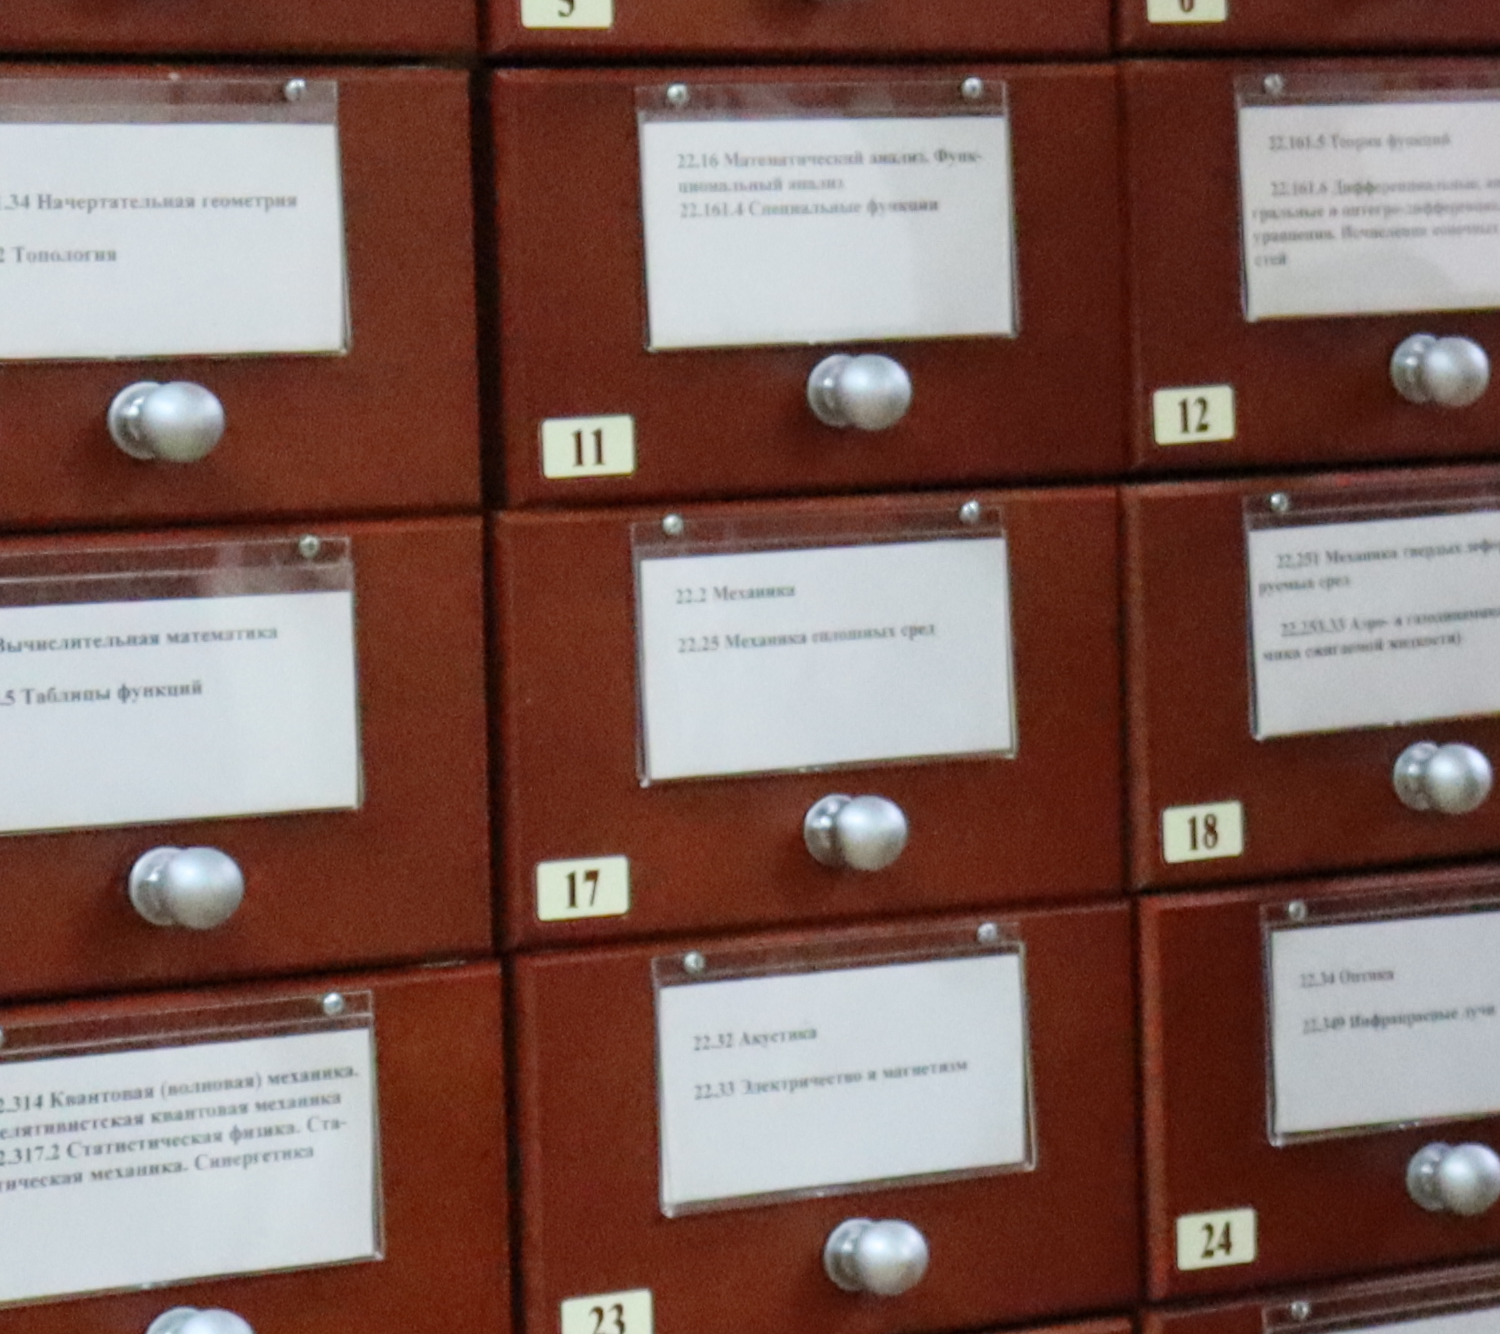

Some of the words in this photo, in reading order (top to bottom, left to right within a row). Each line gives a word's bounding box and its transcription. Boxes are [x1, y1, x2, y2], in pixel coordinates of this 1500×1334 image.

[724, 150, 865, 168] Математический
[36, 193, 196, 215] Начертательная
[201, 195, 298, 213] геометрия
[13, 245, 118, 264] Топология
[1178, 396, 1210, 434] 12
[572, 428, 604, 467] 11
[675, 586, 707, 605] 22.2
[713, 585, 796, 601] Механика
[165, 627, 278, 645] математика
[678, 634, 721, 654] 22.25
[725, 633, 808, 649] Механика
[21, 686, 111, 706] Таблицы
[116, 679, 203, 704] функций
[1188, 813, 1220, 851] 18
[566, 869, 600, 909] 17
[739, 1027, 819, 1048] Акустика
[49, 1086, 155, 1109] Квантовая
[159, 1072, 263, 1100] (волновая)
[267, 1065, 359, 1085] механика.
[742, 1071, 864, 1095] Электричество
[881, 1060, 969, 1079] магнетизм
[149, 1102, 250, 1125] квантовая
[254, 1092, 342, 1113] механика
[64, 1128, 223, 1160] Статистическая
[228, 1123, 300, 1145] физика.
[89, 1161, 188, 1182] механика.
[192, 1143, 315, 1171] Синергетика
[1201, 1221, 1233, 1259] 24
